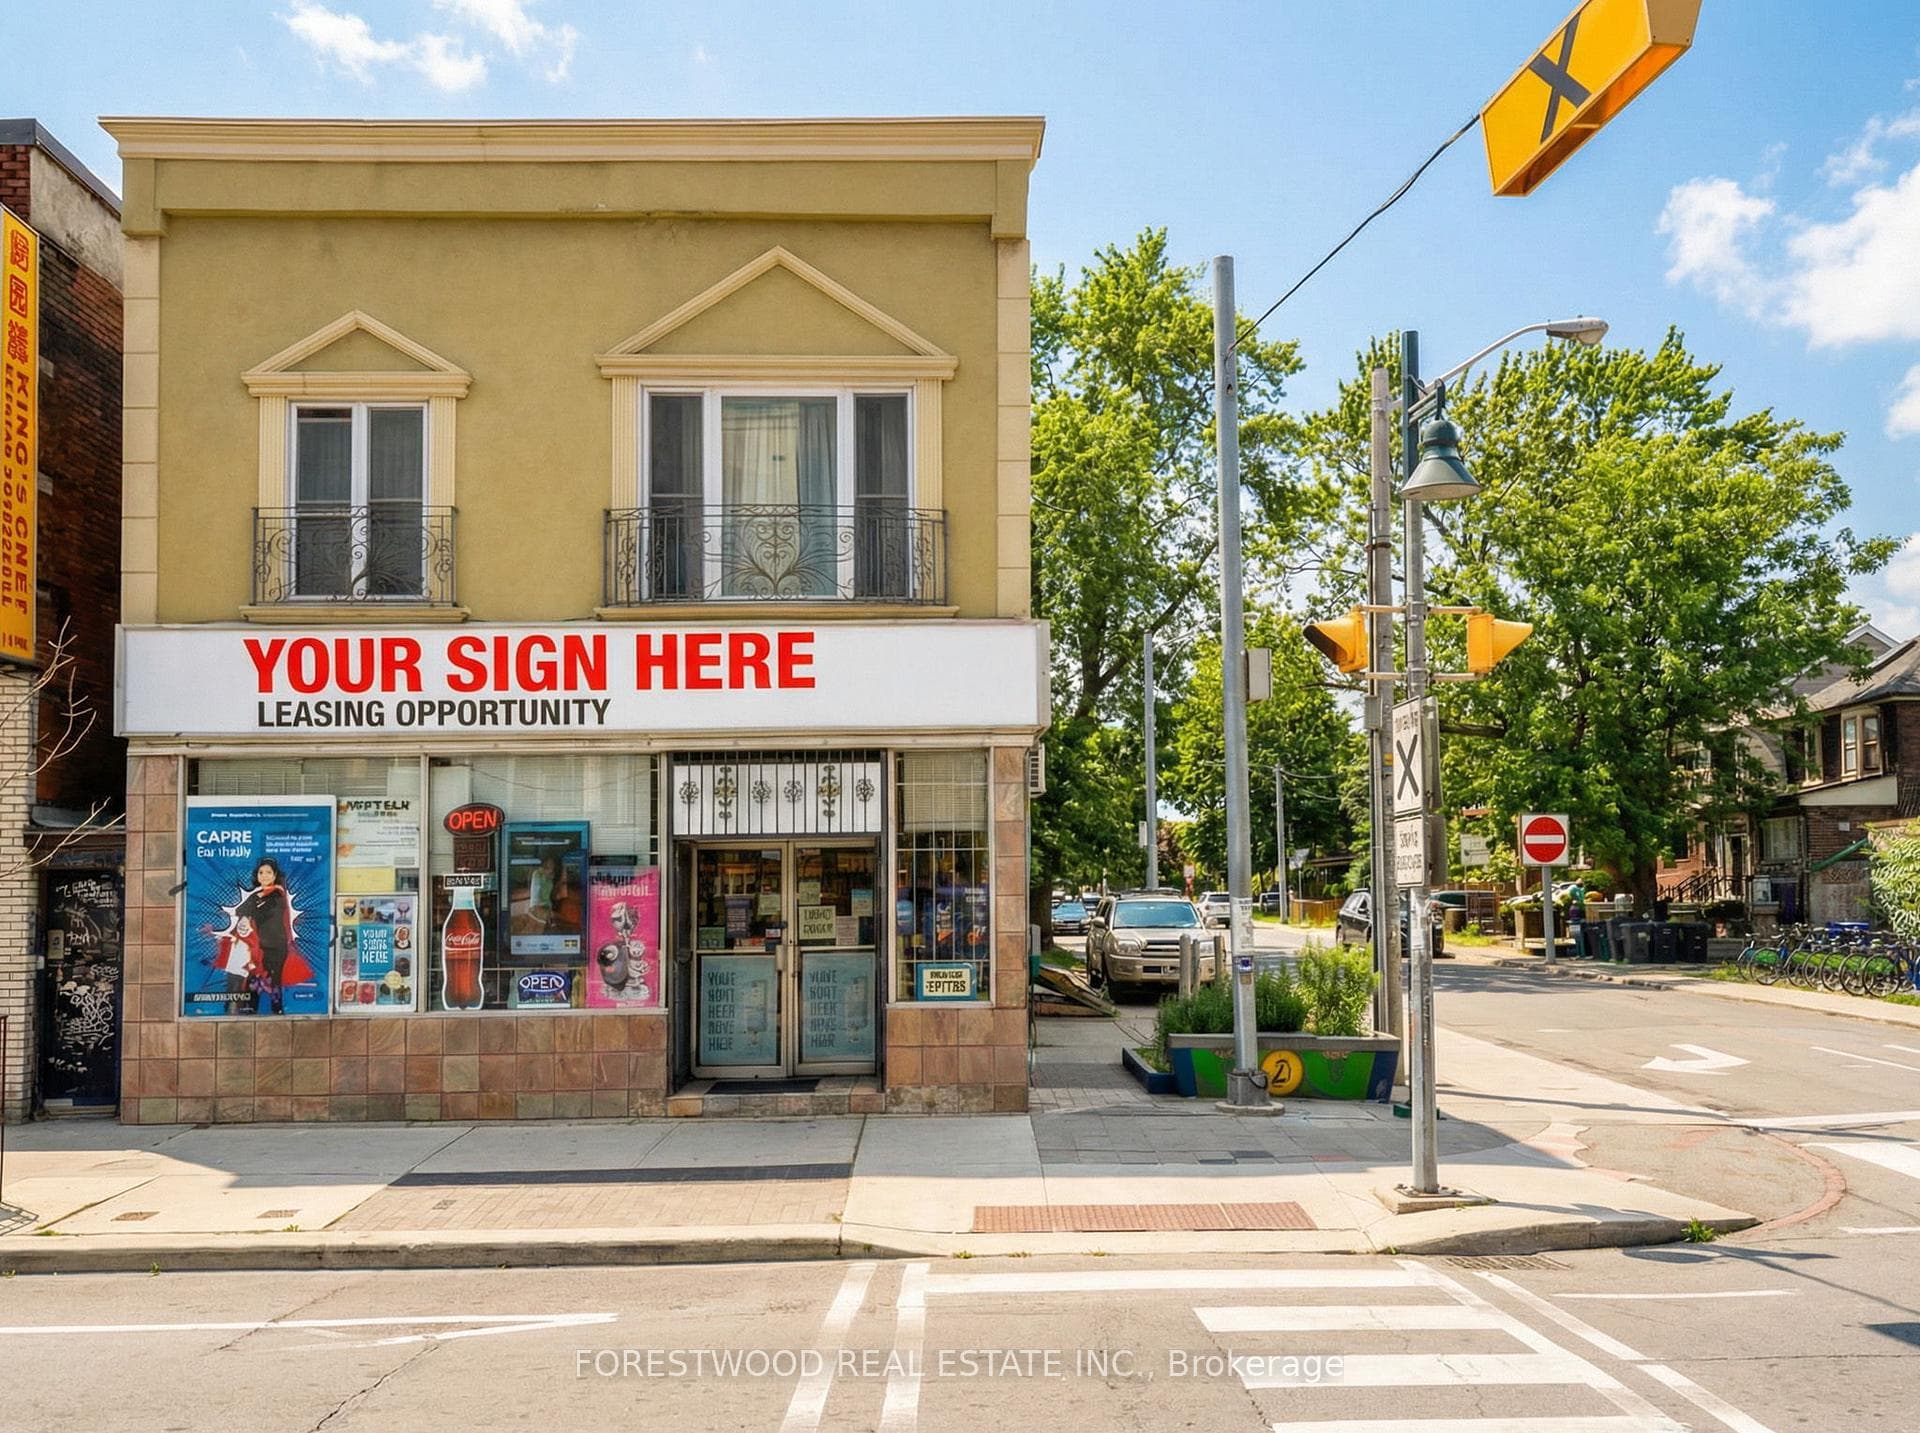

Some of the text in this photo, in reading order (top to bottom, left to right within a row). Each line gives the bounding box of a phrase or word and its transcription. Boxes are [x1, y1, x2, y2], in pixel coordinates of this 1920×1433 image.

[243, 632, 815, 693] YOUR SIGN HERE
[257, 698, 611, 727] LEASING OPPORTUNITY
[449, 810, 497, 830] OPEN
[196, 830, 252, 844] CAPRE
[520, 975, 565, 990] OPEN
